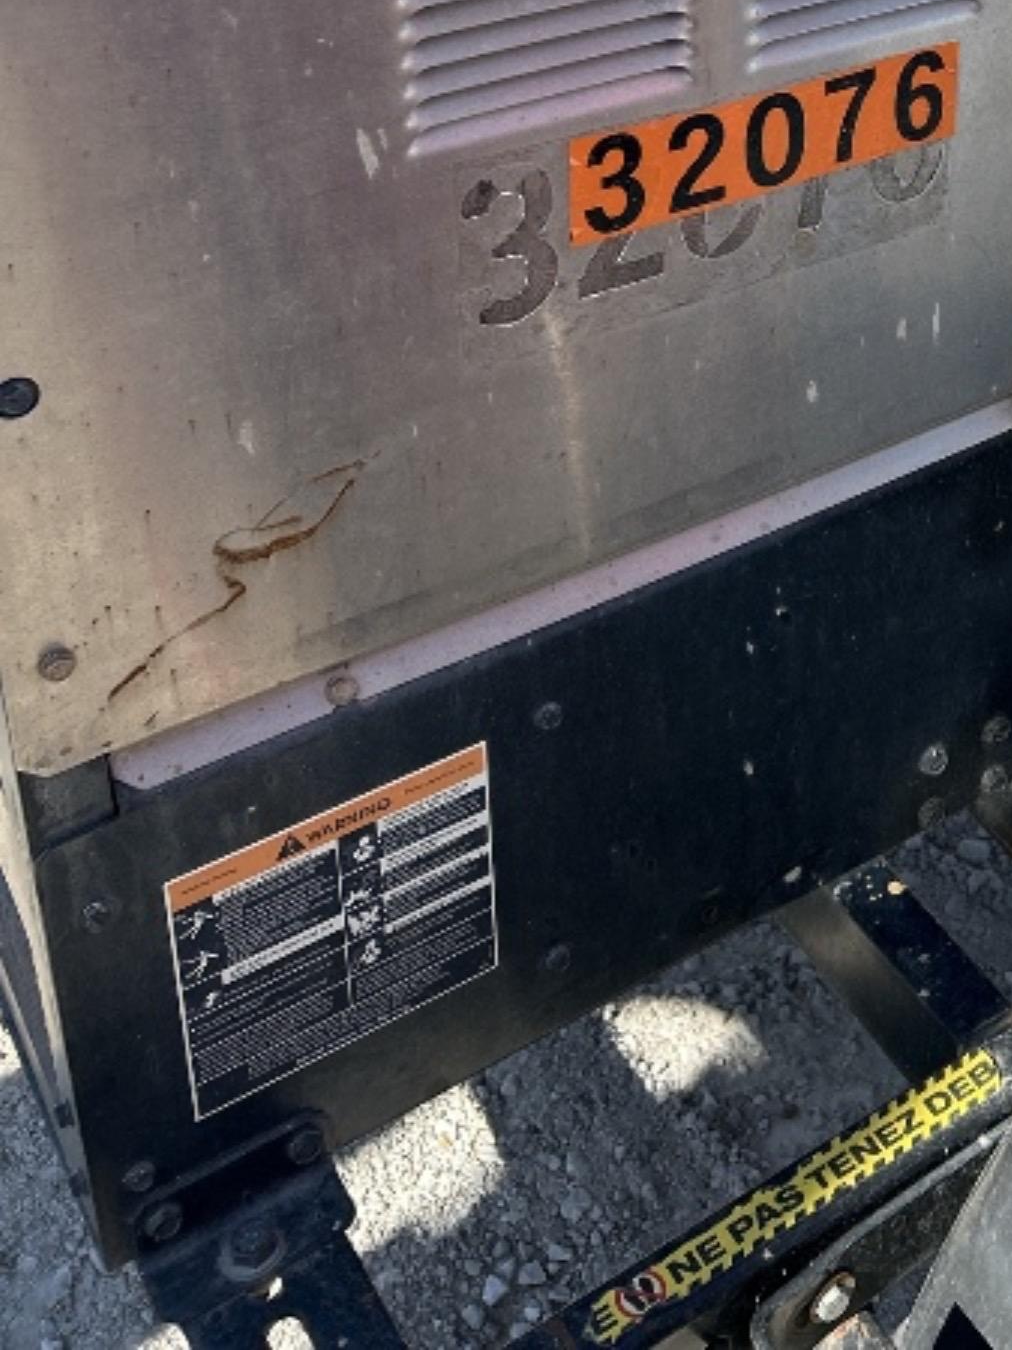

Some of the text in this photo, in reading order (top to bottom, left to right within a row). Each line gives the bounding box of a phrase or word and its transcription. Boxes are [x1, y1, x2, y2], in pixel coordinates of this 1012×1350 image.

[583, 50, 945, 234] 32076
[667, 1235, 721, 1284] NE
[728, 1184, 806, 1243] PAS
[807, 1106, 925, 1189] TENEZ
